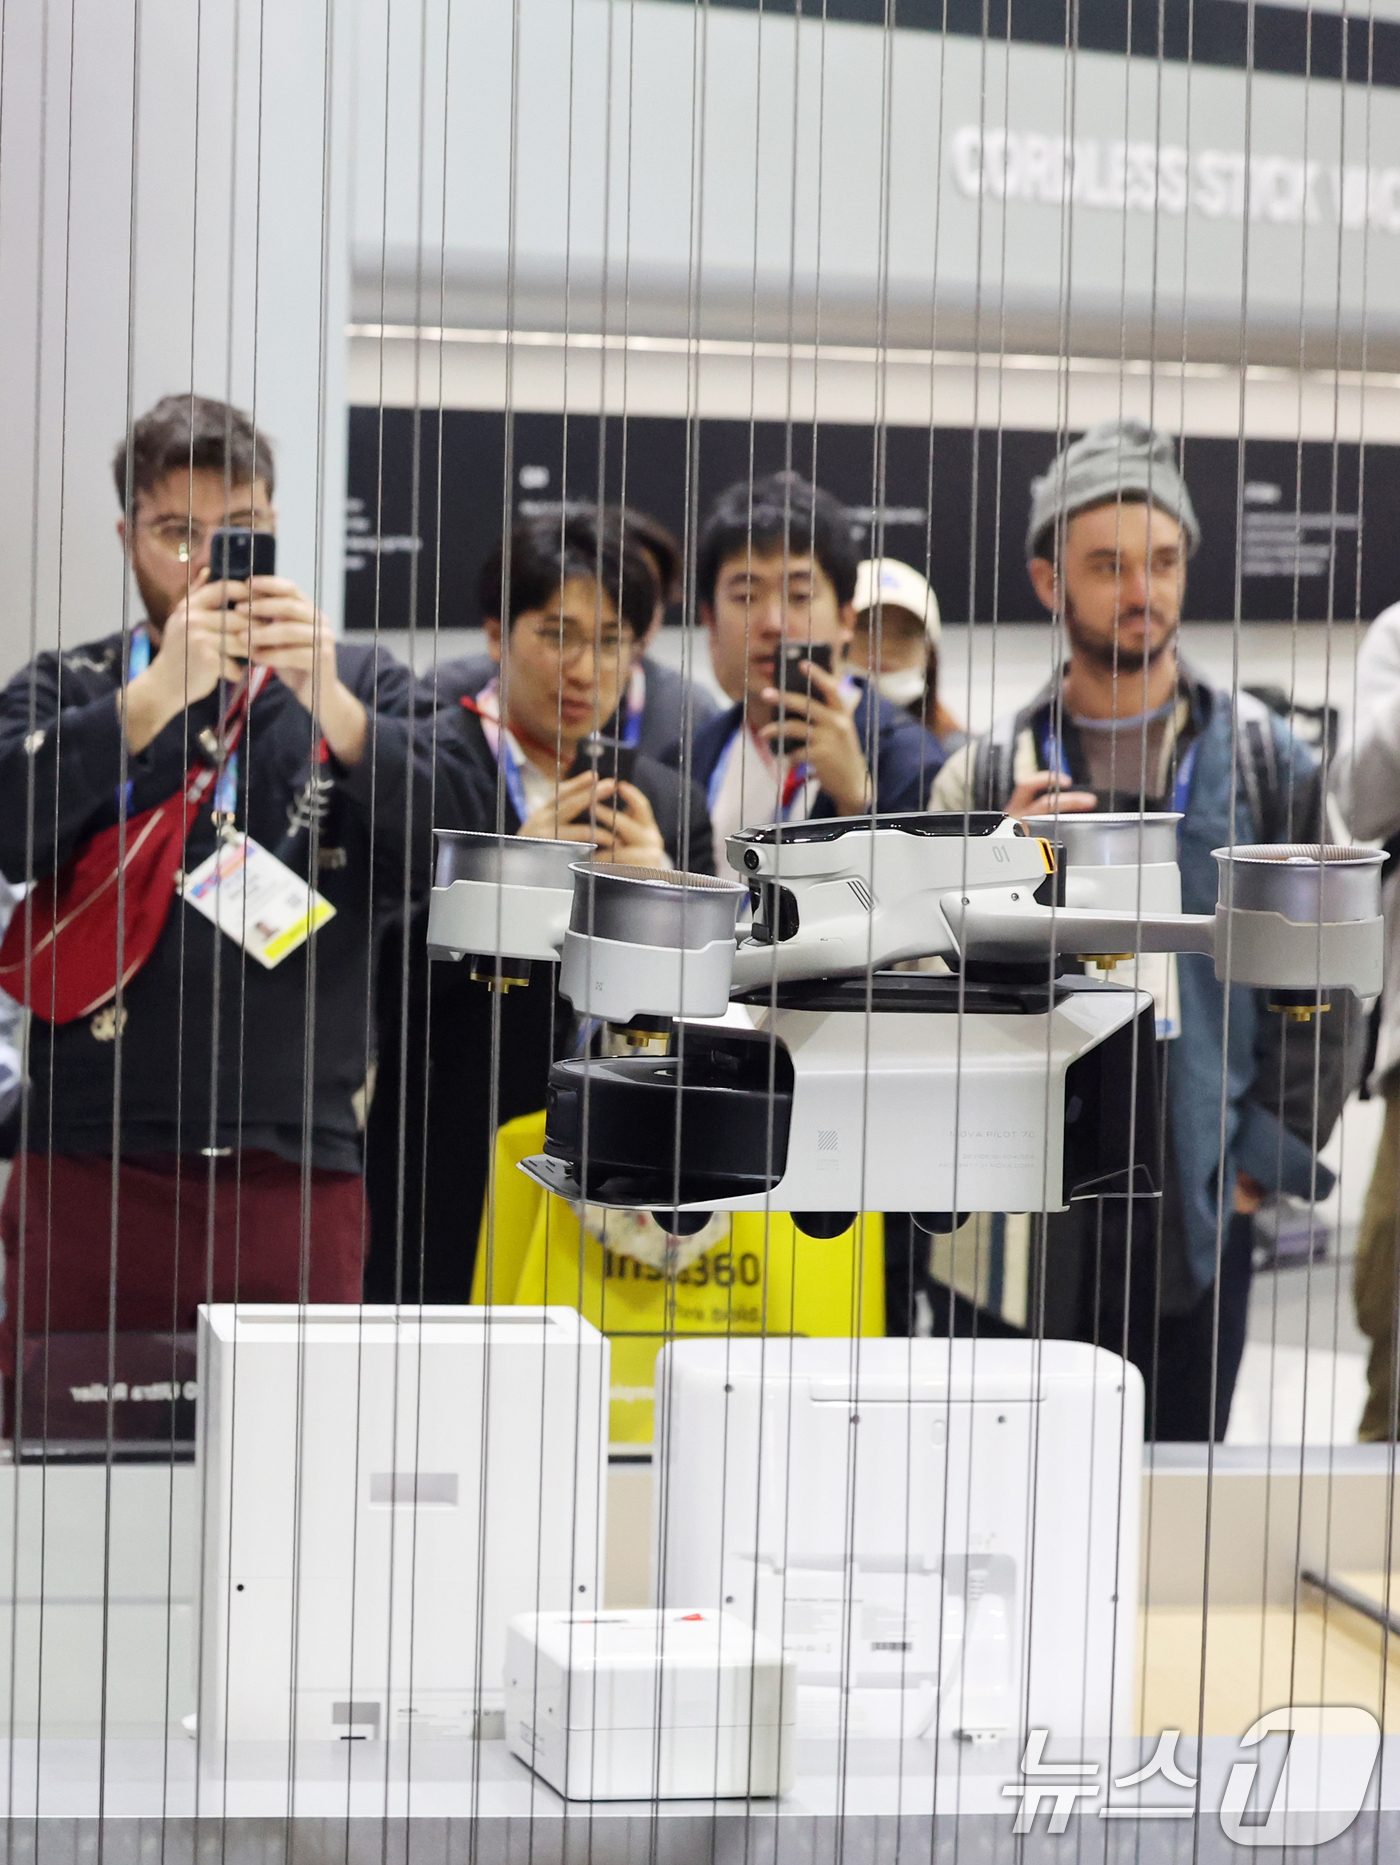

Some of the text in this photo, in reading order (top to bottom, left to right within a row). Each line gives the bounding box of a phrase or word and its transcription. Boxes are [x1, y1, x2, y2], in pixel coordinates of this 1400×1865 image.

[953, 124, 1188, 216] CORDLESS
[1196, 148, 1323, 226] STICK
[992, 845, 1010, 862] 01
[986, 1131, 1016, 1139] PILOT
